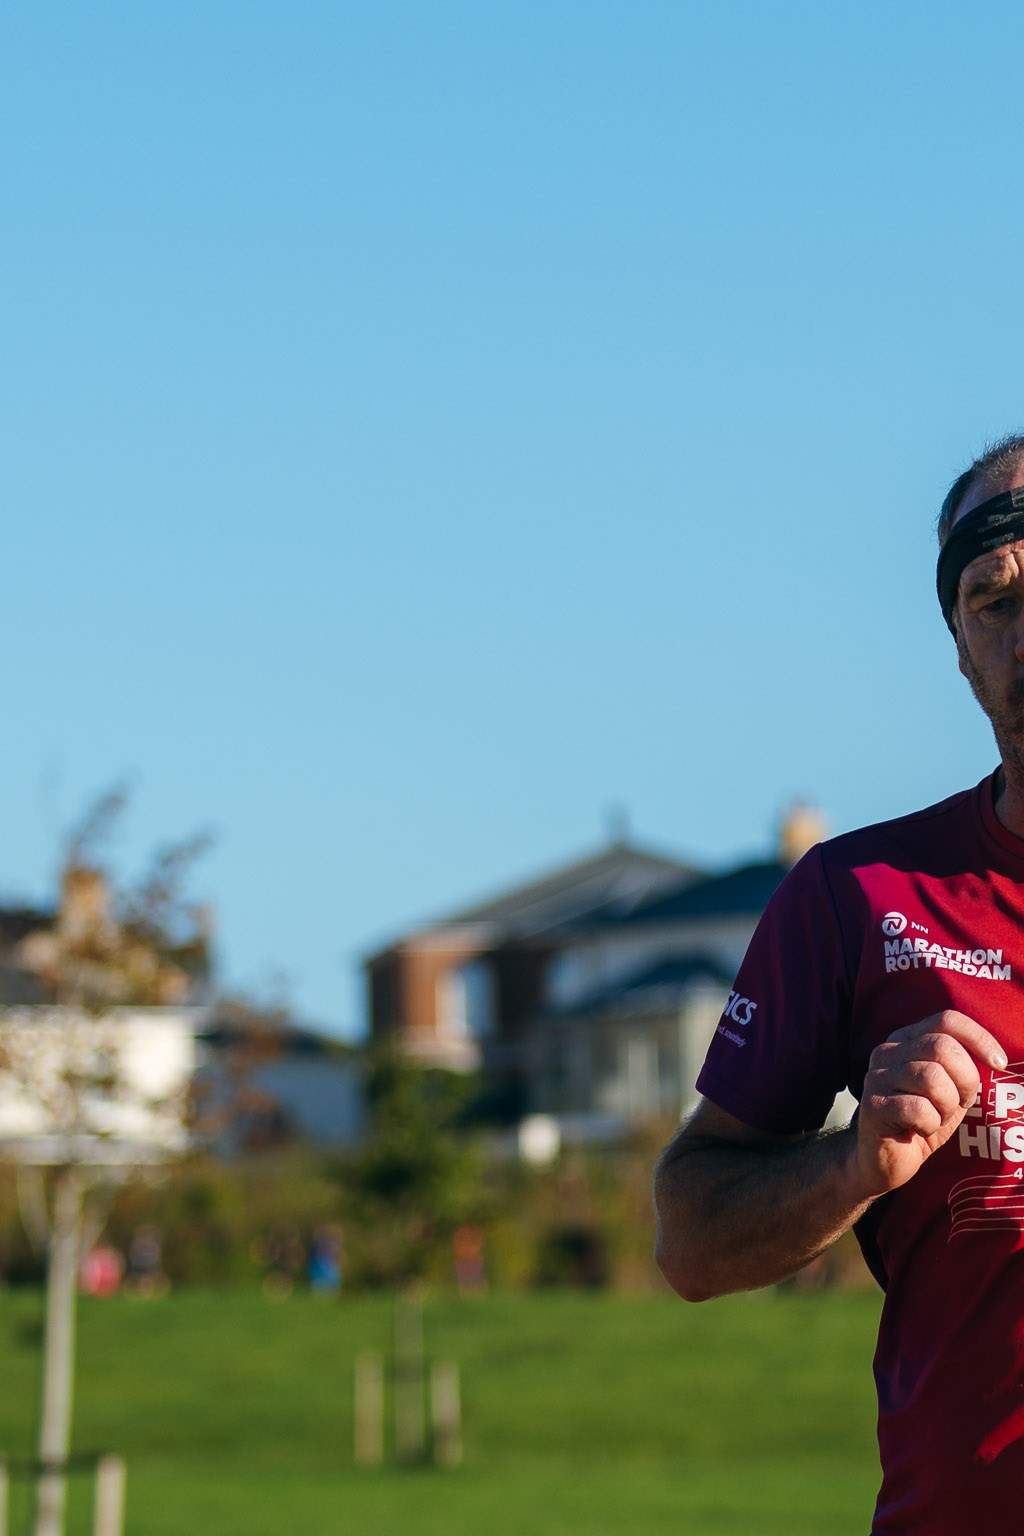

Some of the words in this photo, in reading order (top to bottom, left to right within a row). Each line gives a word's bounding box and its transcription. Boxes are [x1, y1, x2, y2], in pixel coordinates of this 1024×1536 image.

[911, 921, 929, 934] NN
[884, 937, 1003, 965] MARATHON
[885, 952, 1012, 981] ROTTERDAM
